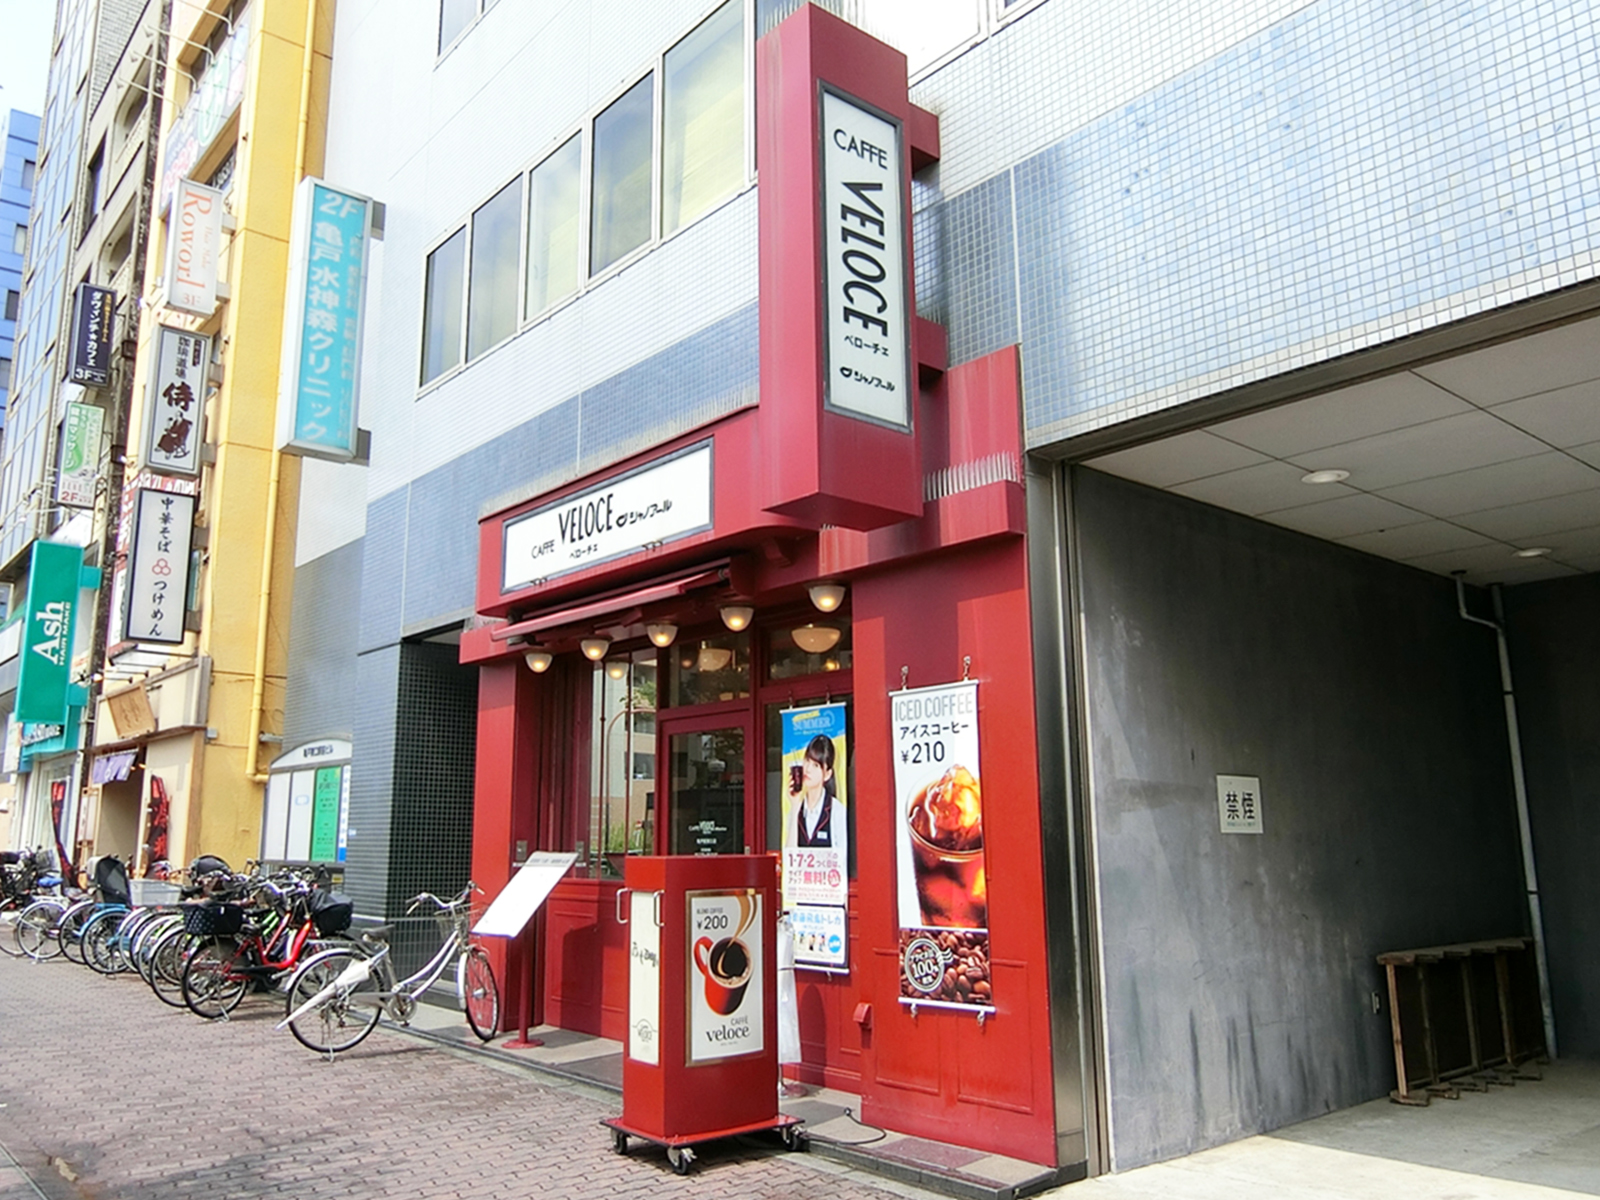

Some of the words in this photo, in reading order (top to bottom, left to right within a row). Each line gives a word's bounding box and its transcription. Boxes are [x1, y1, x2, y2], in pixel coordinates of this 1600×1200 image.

[833, 128, 888, 170] CAFFE
[319, 191, 365, 219] 2F
[841, 182, 888, 338] VELOCE
[75, 367, 92, 380] 3F
[162, 381, 195, 412] 侍
[61, 491, 79, 503] 2F
[157, 497, 175, 553] 中華そば
[558, 493, 614, 545] VELOCE
[62, 602, 72, 635] MAKE
[149, 579, 168, 636] つけめん
[31, 601, 65, 665] Ash
[58, 637, 68, 666] HAIR
[894, 698, 923, 723] ICED
[924, 691, 974, 719] COFFEE
[900, 721, 970, 741] アイスコーヒー
[901, 740, 946, 765] ¥210
[1226, 790, 1256, 820] 禁煙
[696, 914, 729, 930] ¥200
[706, 1024, 751, 1042] veloce
